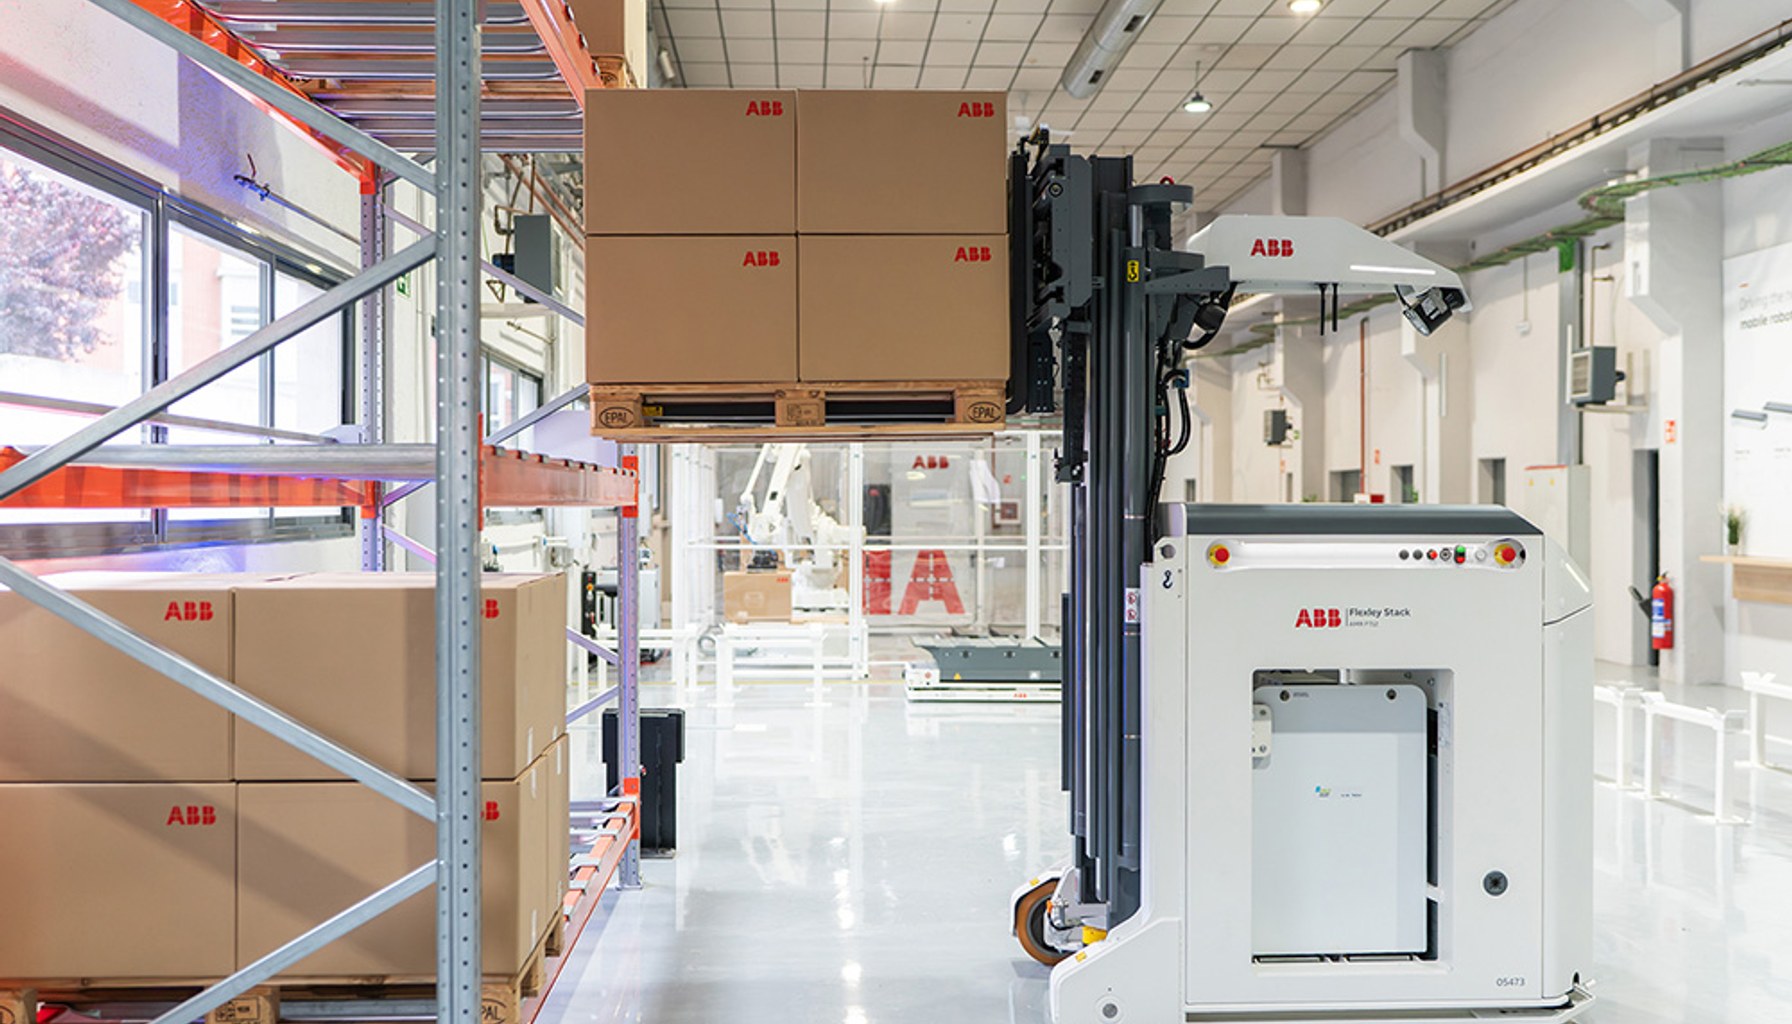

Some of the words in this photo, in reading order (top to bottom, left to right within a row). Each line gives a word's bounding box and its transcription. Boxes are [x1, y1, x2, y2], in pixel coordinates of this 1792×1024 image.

[746, 101, 783, 116] ABB
[957, 102, 994, 117] ABB
[954, 246, 991, 262] ABB
[1251, 239, 1294, 257] ABB
[743, 251, 780, 266] ABB
[1770, 309, 1792, 325] robo
[605, 412, 627, 424] EPAL
[973, 406, 995, 419] EPAL
[912, 456, 949, 469] ABB
[164, 602, 214, 621] ABB
[1295, 608, 1342, 628] ABB
[1349, 608, 1382, 618] Flexley
[1384, 608, 1411, 617] Stack
[167, 806, 217, 826] ABB
